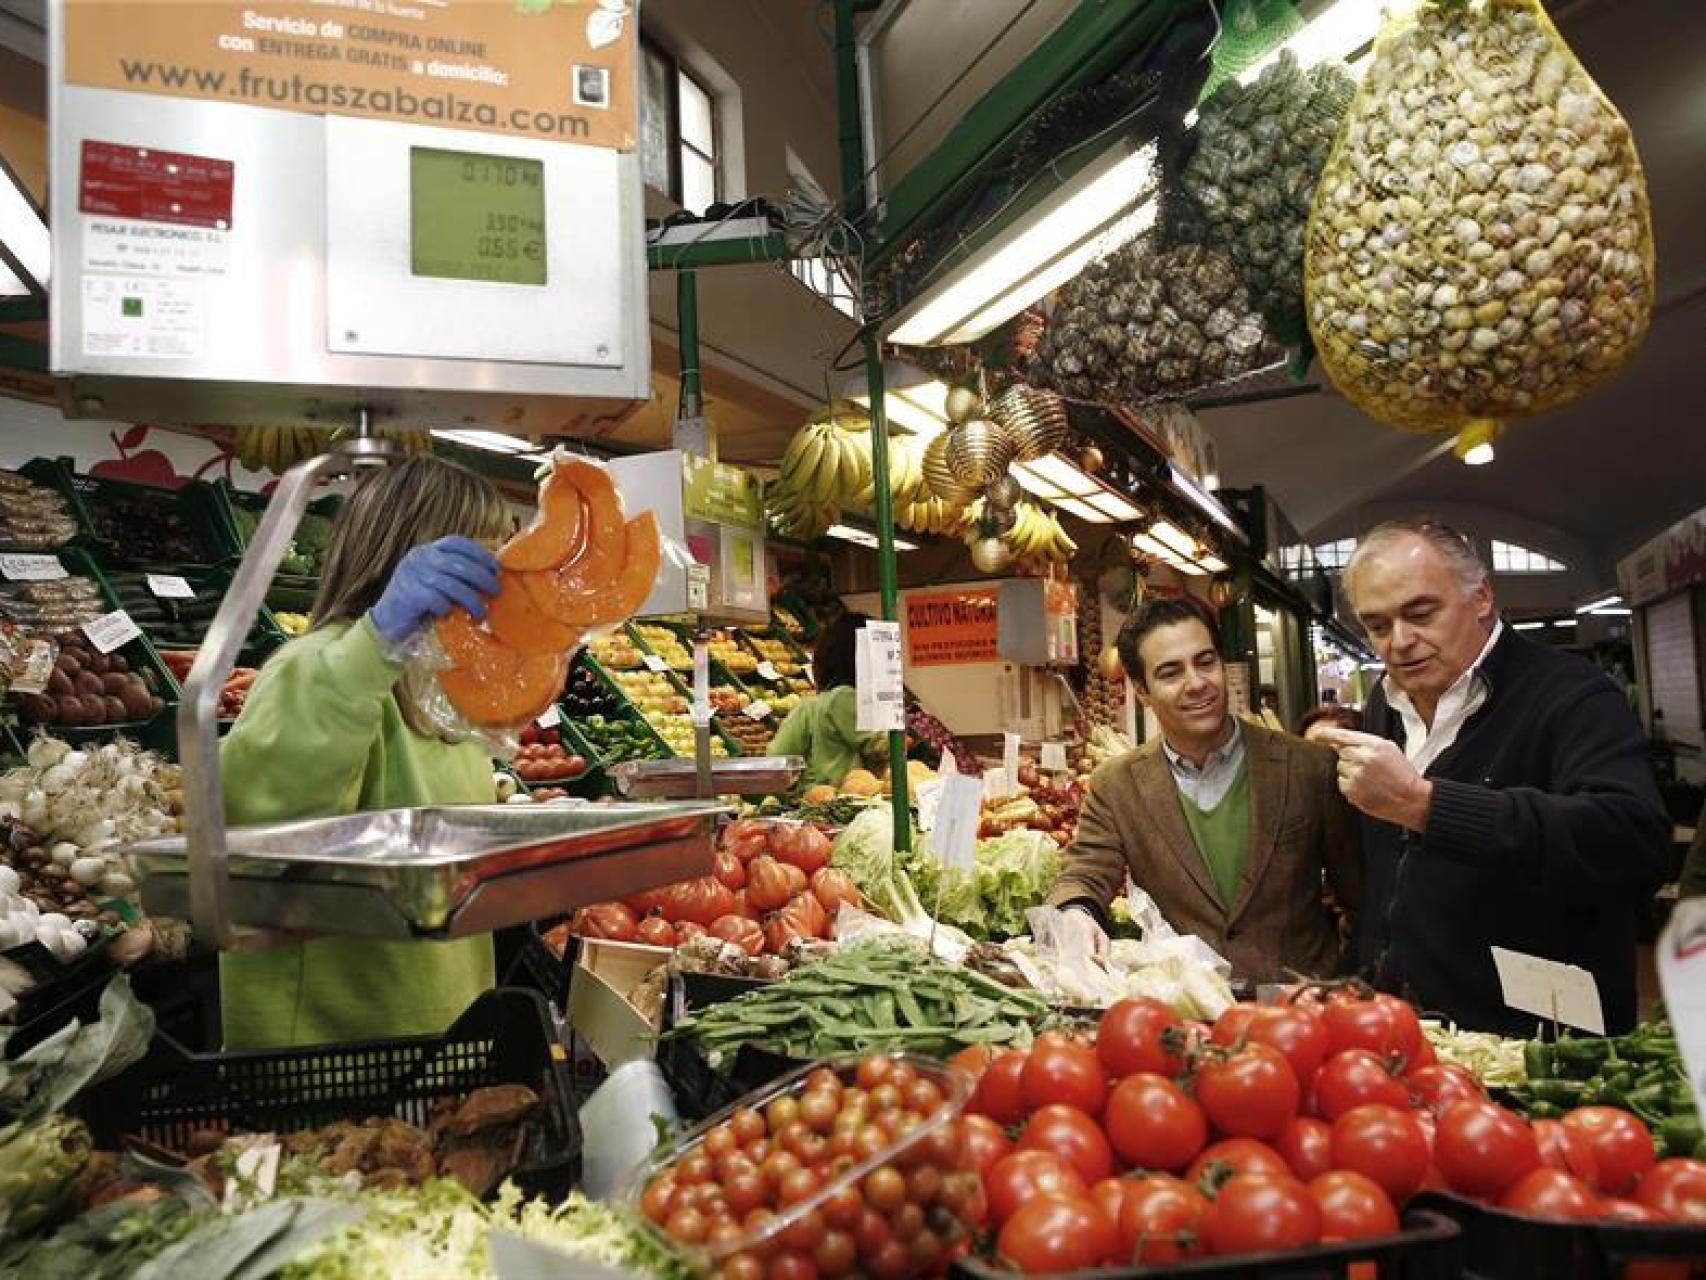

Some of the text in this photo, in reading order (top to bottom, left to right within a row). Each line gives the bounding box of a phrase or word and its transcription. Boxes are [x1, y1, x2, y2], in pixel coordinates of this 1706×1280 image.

[218, 34, 509, 86] con ENTREGA GRATIS a domicilio:
[243, 10, 487, 58] Servicio de COMPRA ONLINE
[119, 57, 589, 138] www.frutaszabalza.com
